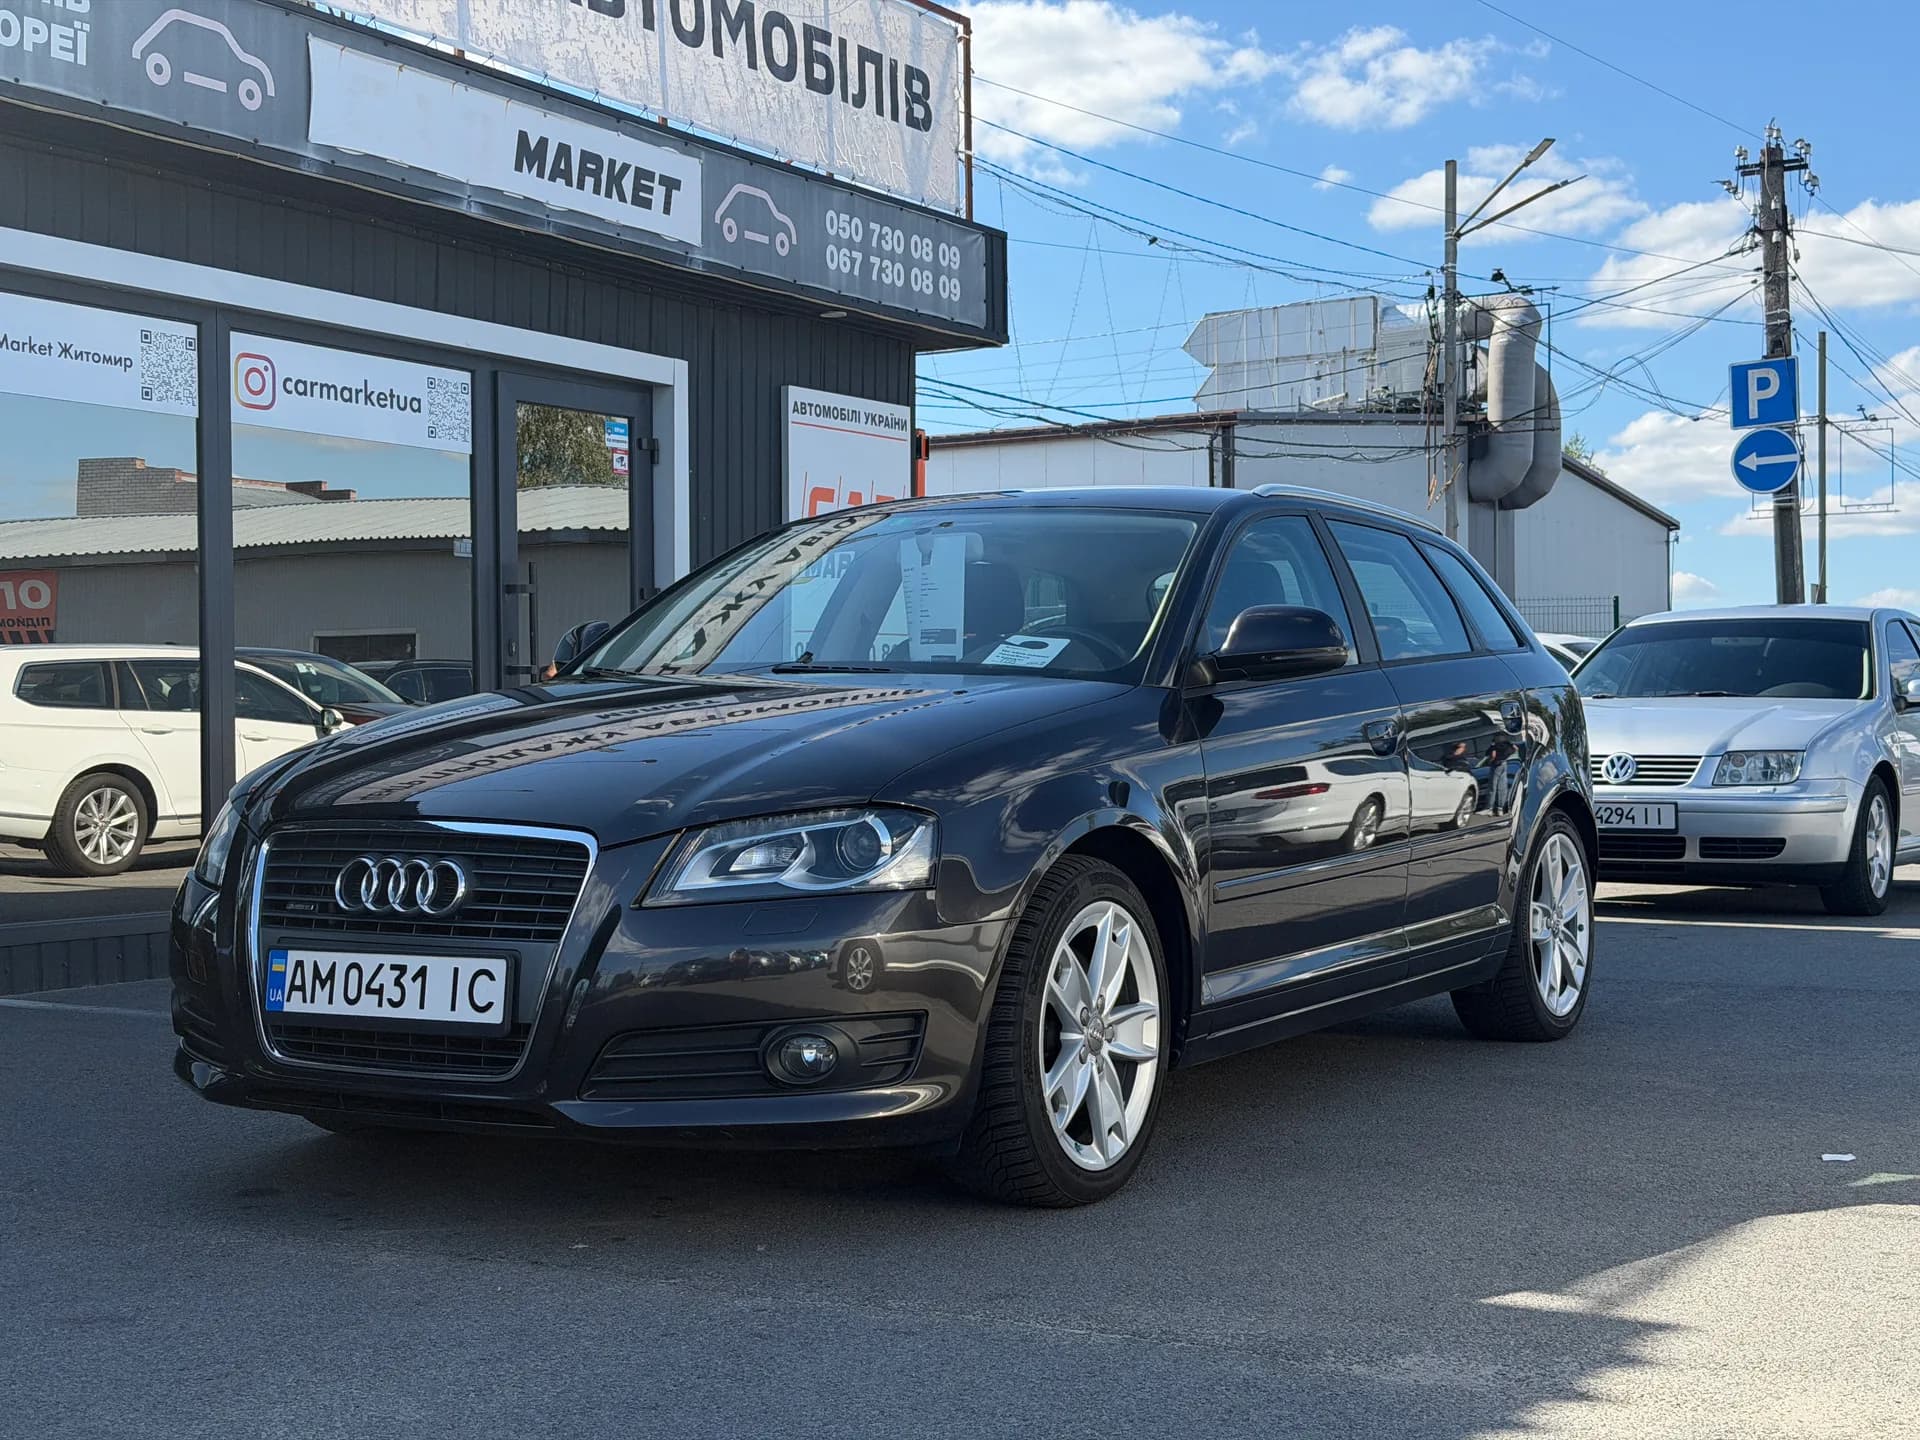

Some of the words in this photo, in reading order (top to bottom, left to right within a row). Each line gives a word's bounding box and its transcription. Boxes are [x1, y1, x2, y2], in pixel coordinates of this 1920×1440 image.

[569, 0, 933, 133] ОМОБІЛІВ
[514, 129, 682, 216] MARKET
[825, 209, 863, 243] 050
[869, 222, 905, 254] 730
[910, 234, 934, 262] 08
[938, 242, 961, 270] 09
[826, 244, 863, 277] 067
[869, 255, 905, 287] 730
[910, 267, 934, 295] 08
[938, 274, 961, 302] 09
[57, 341, 134, 372] Житомир
[282, 377, 422, 414] carmarketua
[792, 400, 861, 423] АВТОМОБІЛІ
[863, 411, 908, 432] УКРАЇНИ
[1747, 368, 1780, 419] P
[269, 988, 283, 1002] UA
[450, 966, 497, 1014] IC
